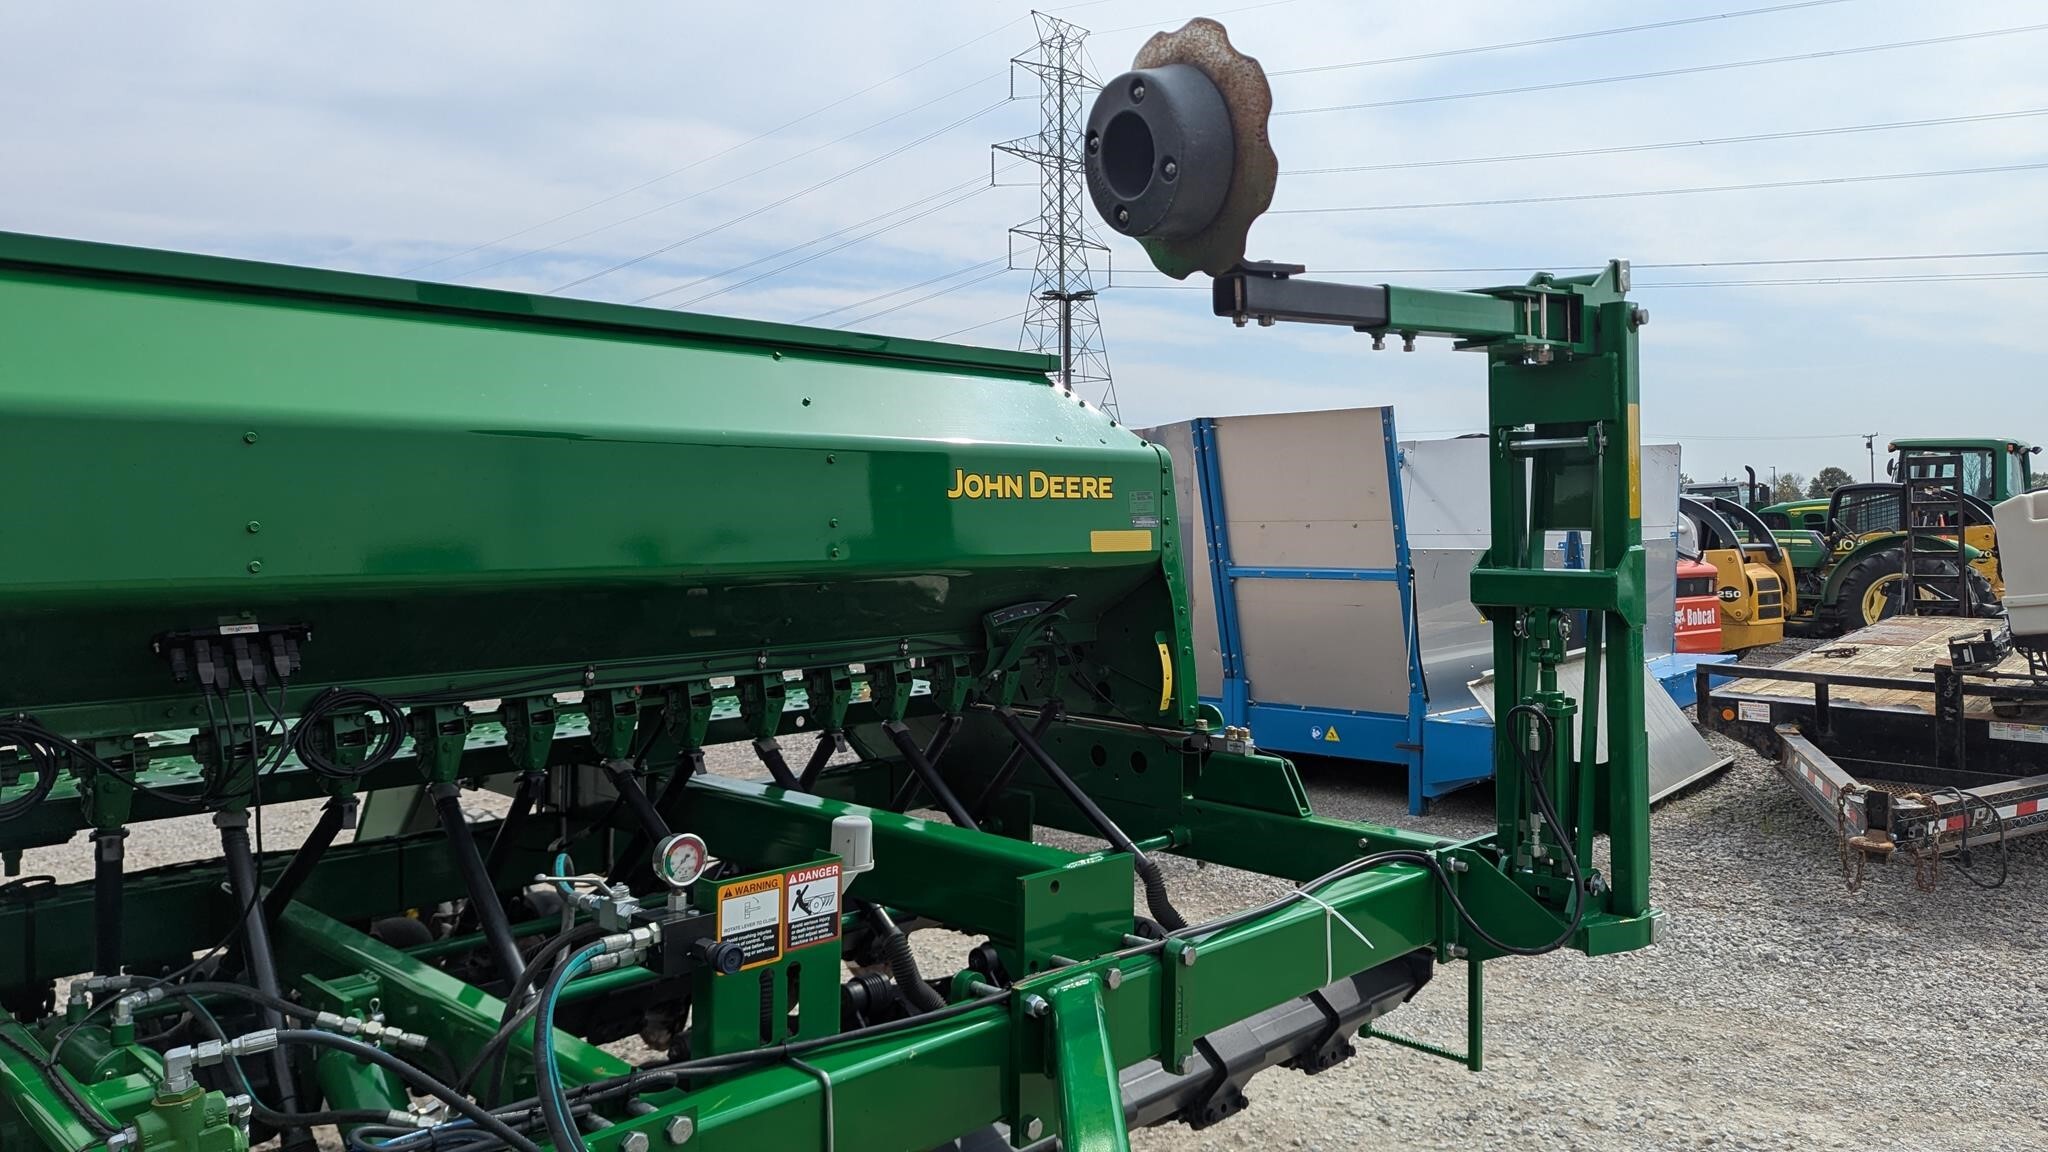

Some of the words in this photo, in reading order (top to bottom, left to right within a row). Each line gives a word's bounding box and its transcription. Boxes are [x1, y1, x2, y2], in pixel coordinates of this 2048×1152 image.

[947, 468, 1024, 500] JOHN
[1028, 469, 1114, 500] DEERE
[1717, 590, 1742, 599] 250
[1687, 607, 1715, 626] Bobcat
[798, 865, 839, 882] DANGER
[734, 879, 778, 895] WARNING
[724, 924, 741, 932] ROTATE
[741, 921, 756, 929] LEVER
[763, 916, 777, 924] CLOSE
[738, 932, 756, 941] crushing
[757, 929, 772, 937] injuries
[751, 942, 765, 950] before
[756, 946, 775, 954] servicing
